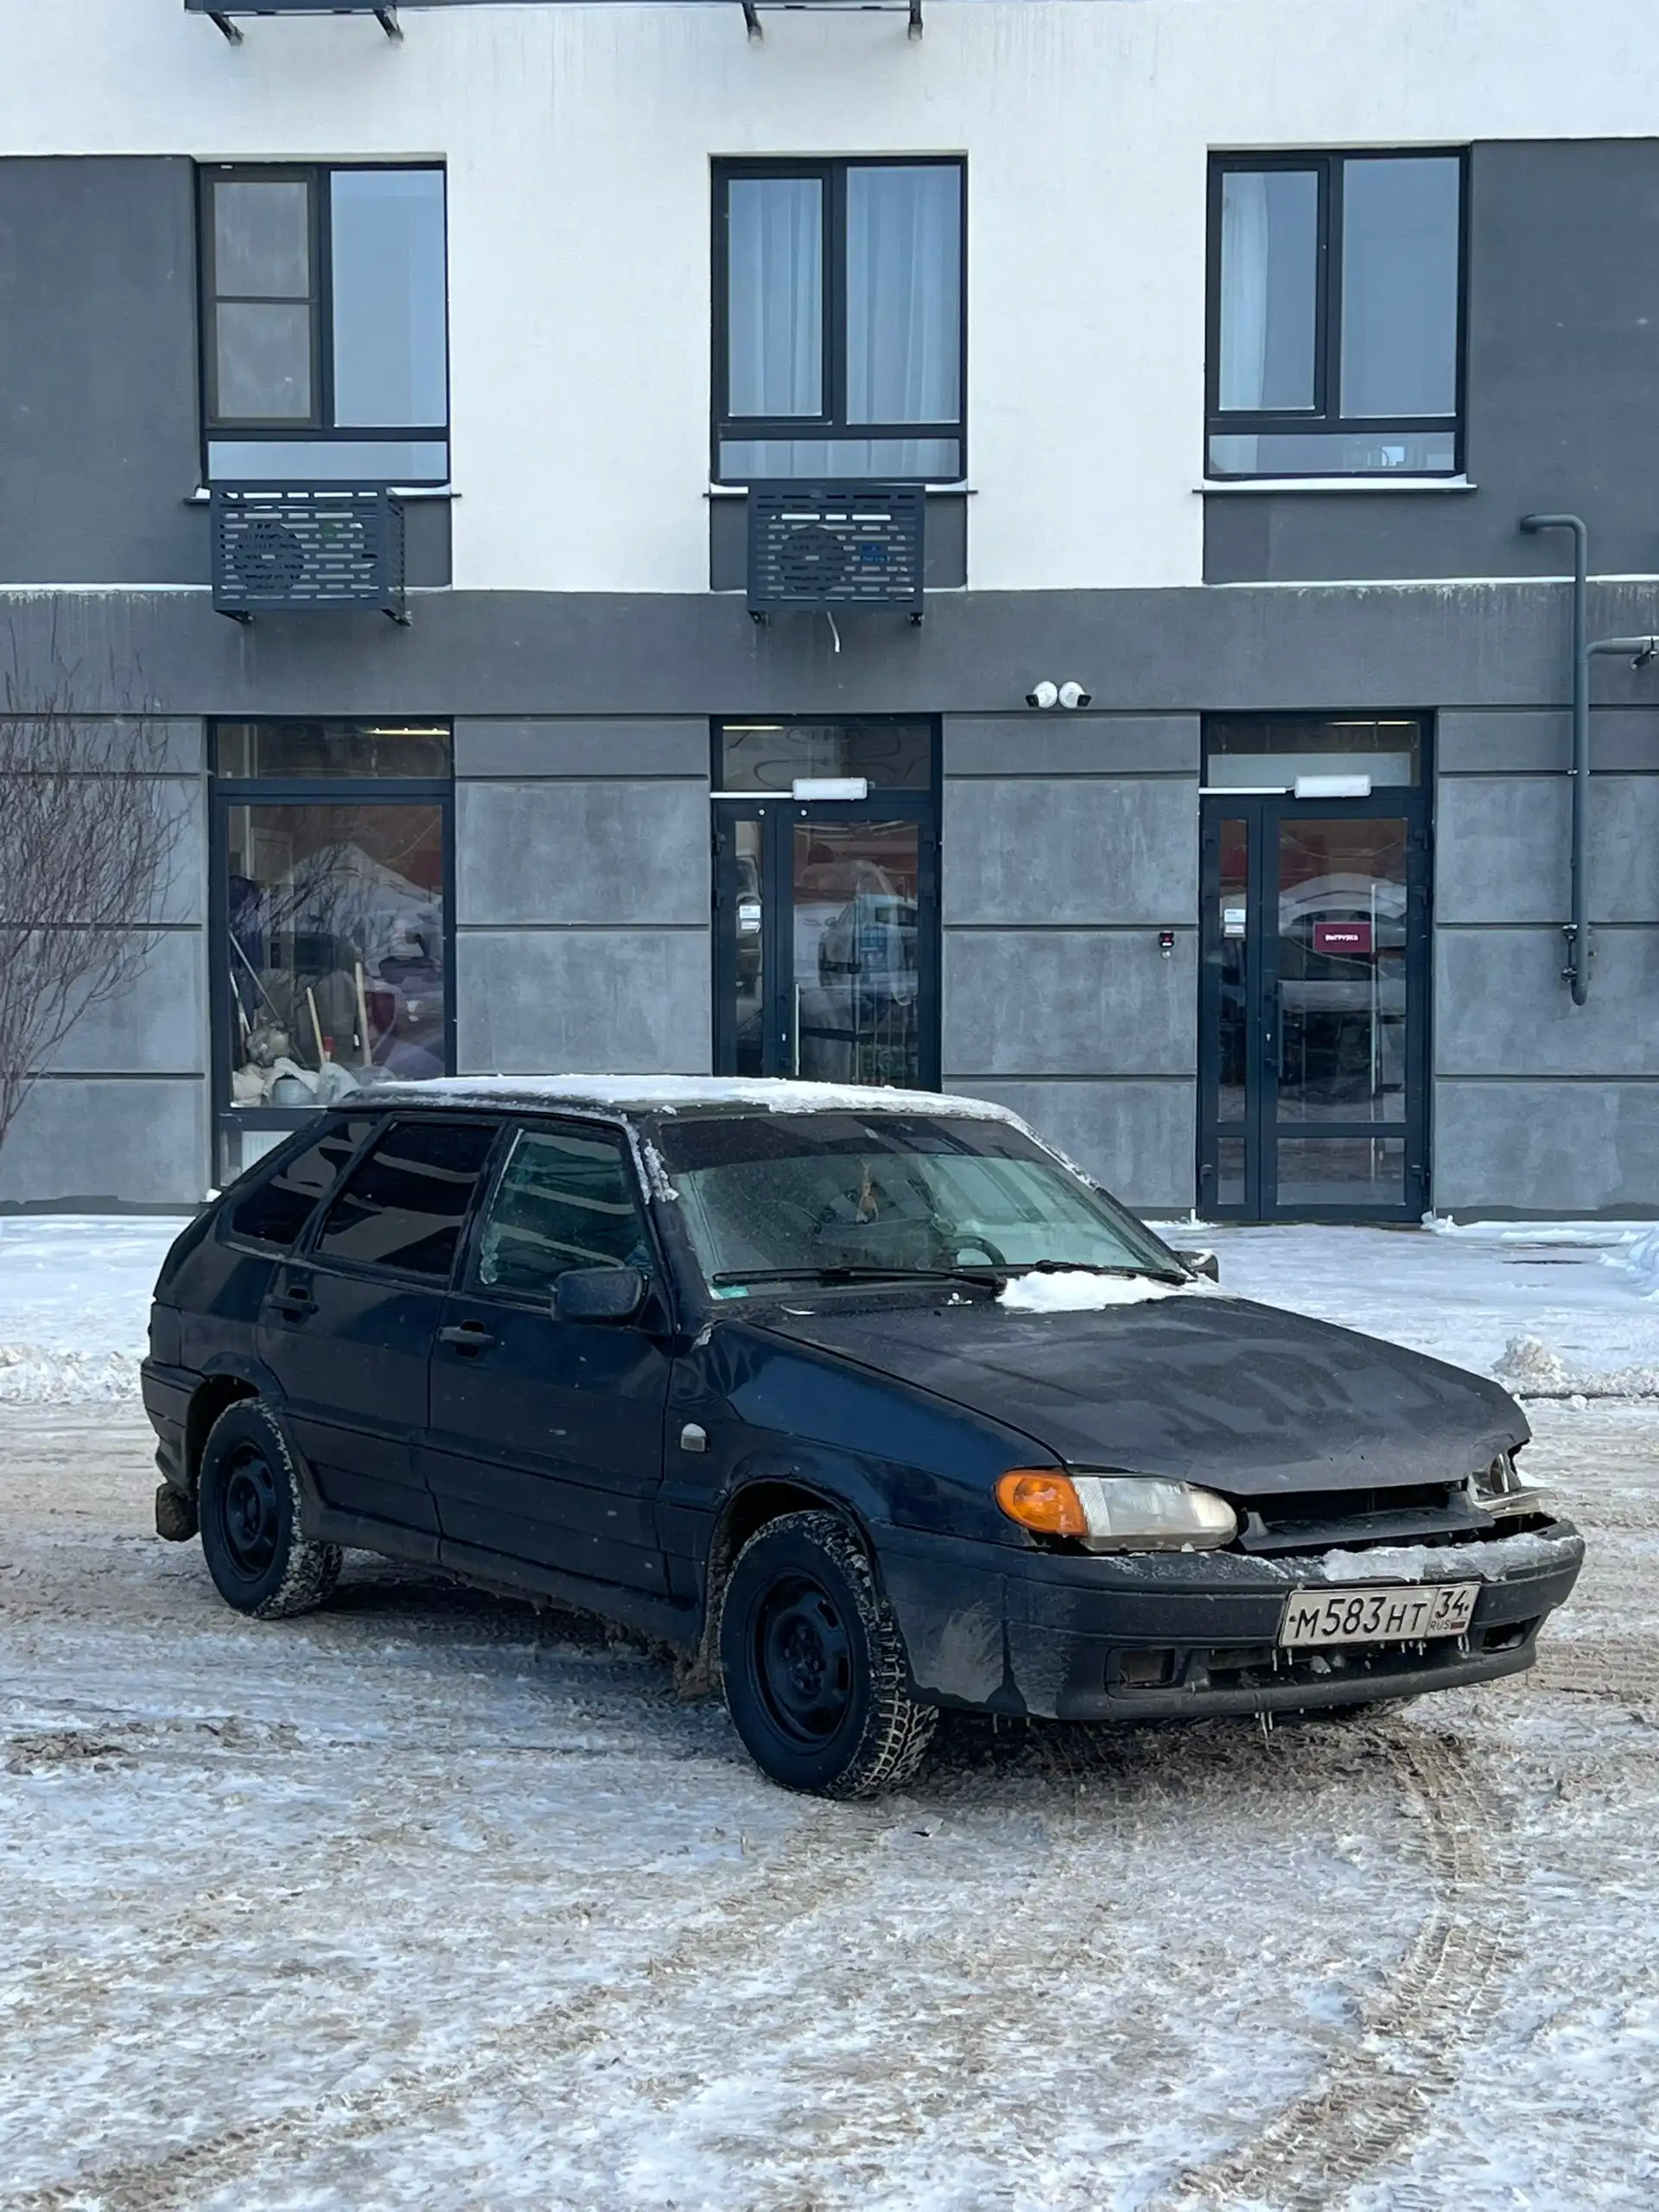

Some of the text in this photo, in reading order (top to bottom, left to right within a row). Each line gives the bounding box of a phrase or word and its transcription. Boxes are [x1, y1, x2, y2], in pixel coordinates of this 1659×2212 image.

[1295, 1590, 1467, 1638] М583НТ 34
[1429, 1619, 1451, 1631] RUS
